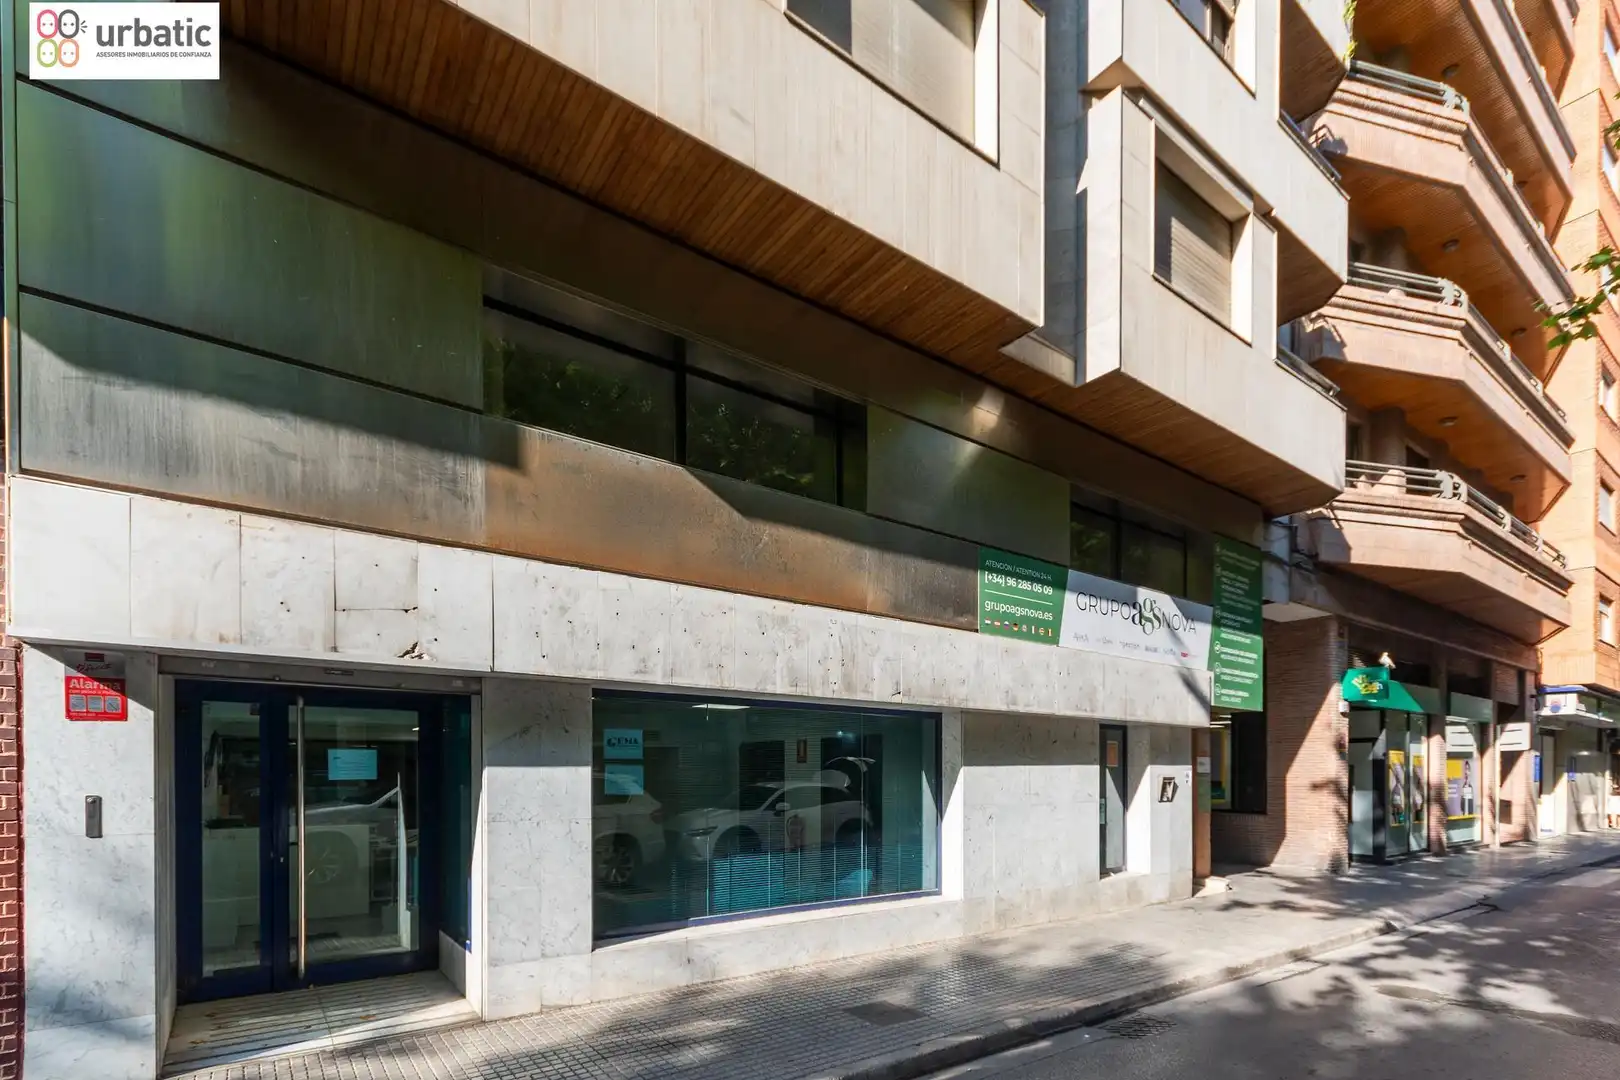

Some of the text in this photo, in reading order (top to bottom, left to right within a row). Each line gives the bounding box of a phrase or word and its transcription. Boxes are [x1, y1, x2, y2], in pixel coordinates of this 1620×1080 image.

[985, 571, 1053, 595] [+34] 96 285 05 09
[984, 600, 1053, 620] grupoagsnova.es
[69, 678, 120, 689] Alarma
